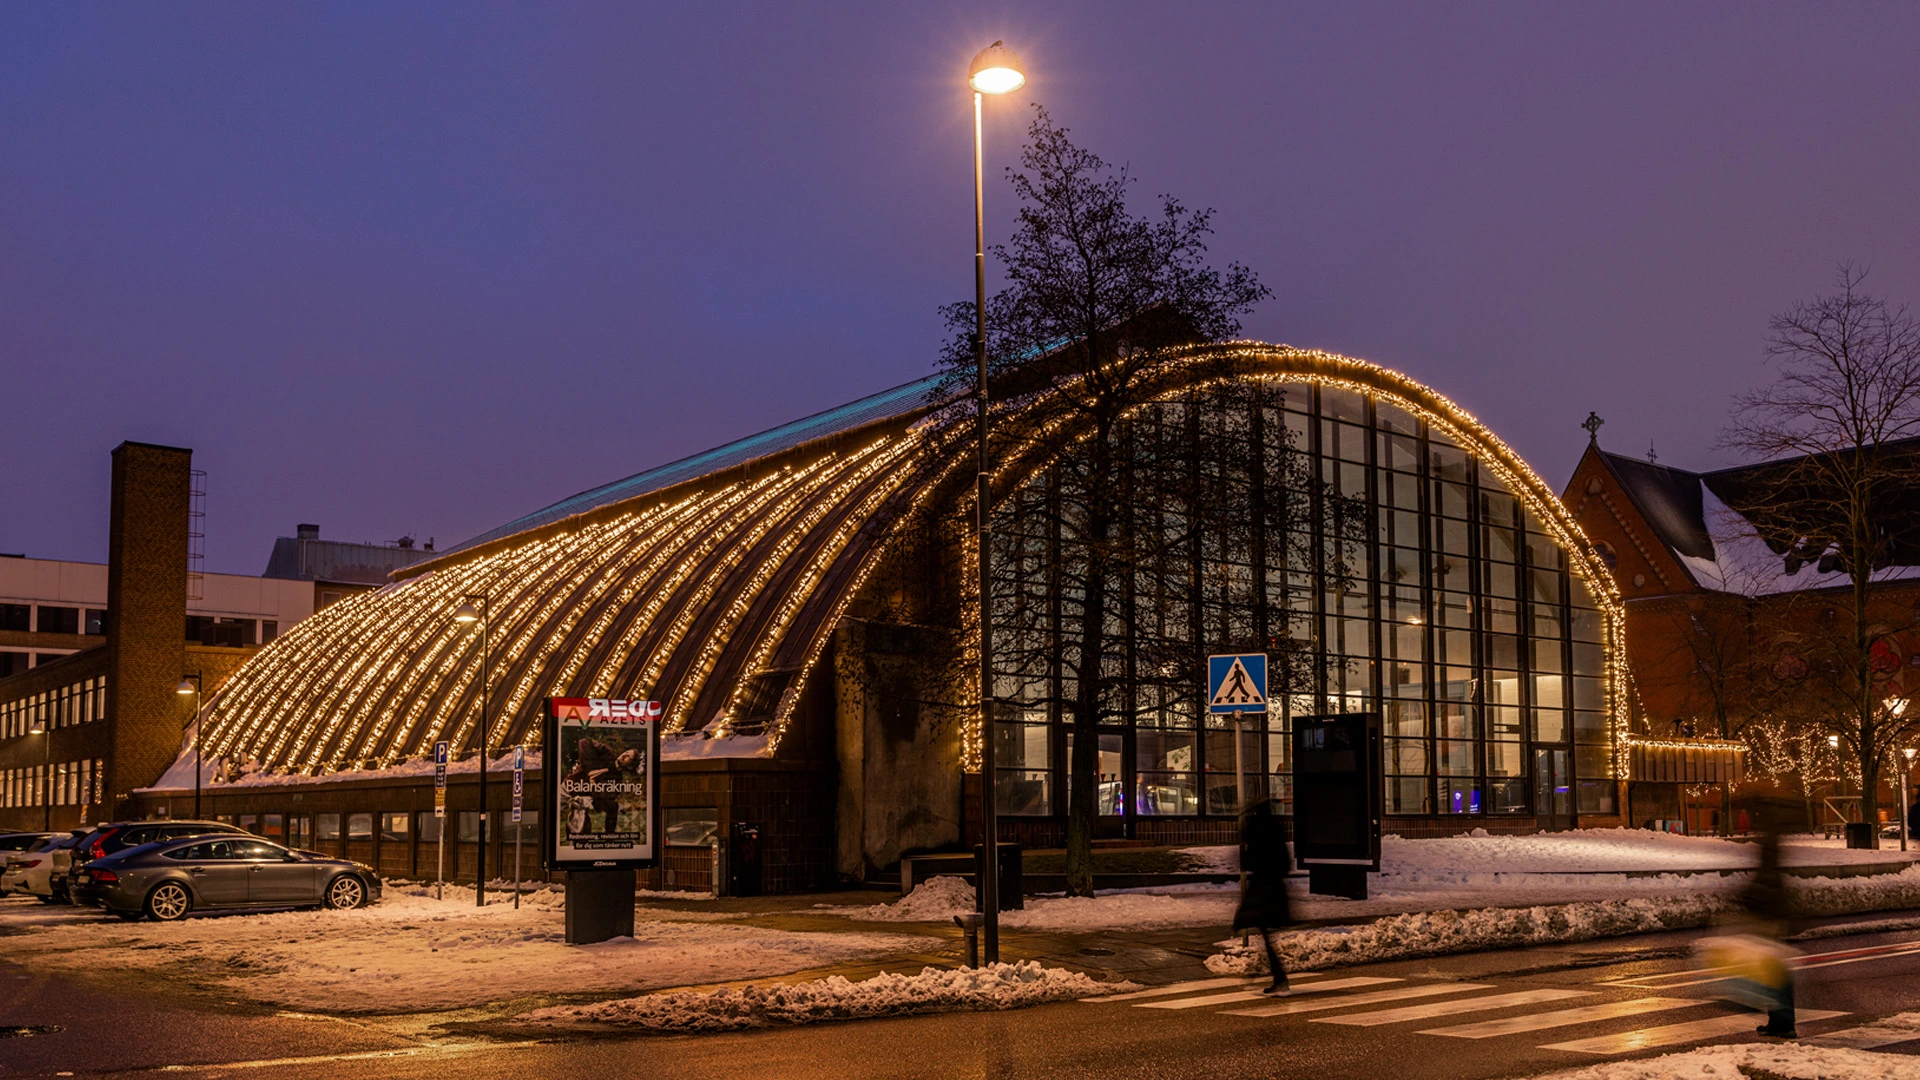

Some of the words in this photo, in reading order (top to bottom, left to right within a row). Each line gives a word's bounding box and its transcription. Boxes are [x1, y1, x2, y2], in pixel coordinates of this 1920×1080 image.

[600, 715, 646, 725] AZETS
[439, 744, 445, 763] P
[516, 748, 522, 768] P
[566, 779, 642, 795] Balansräkning
